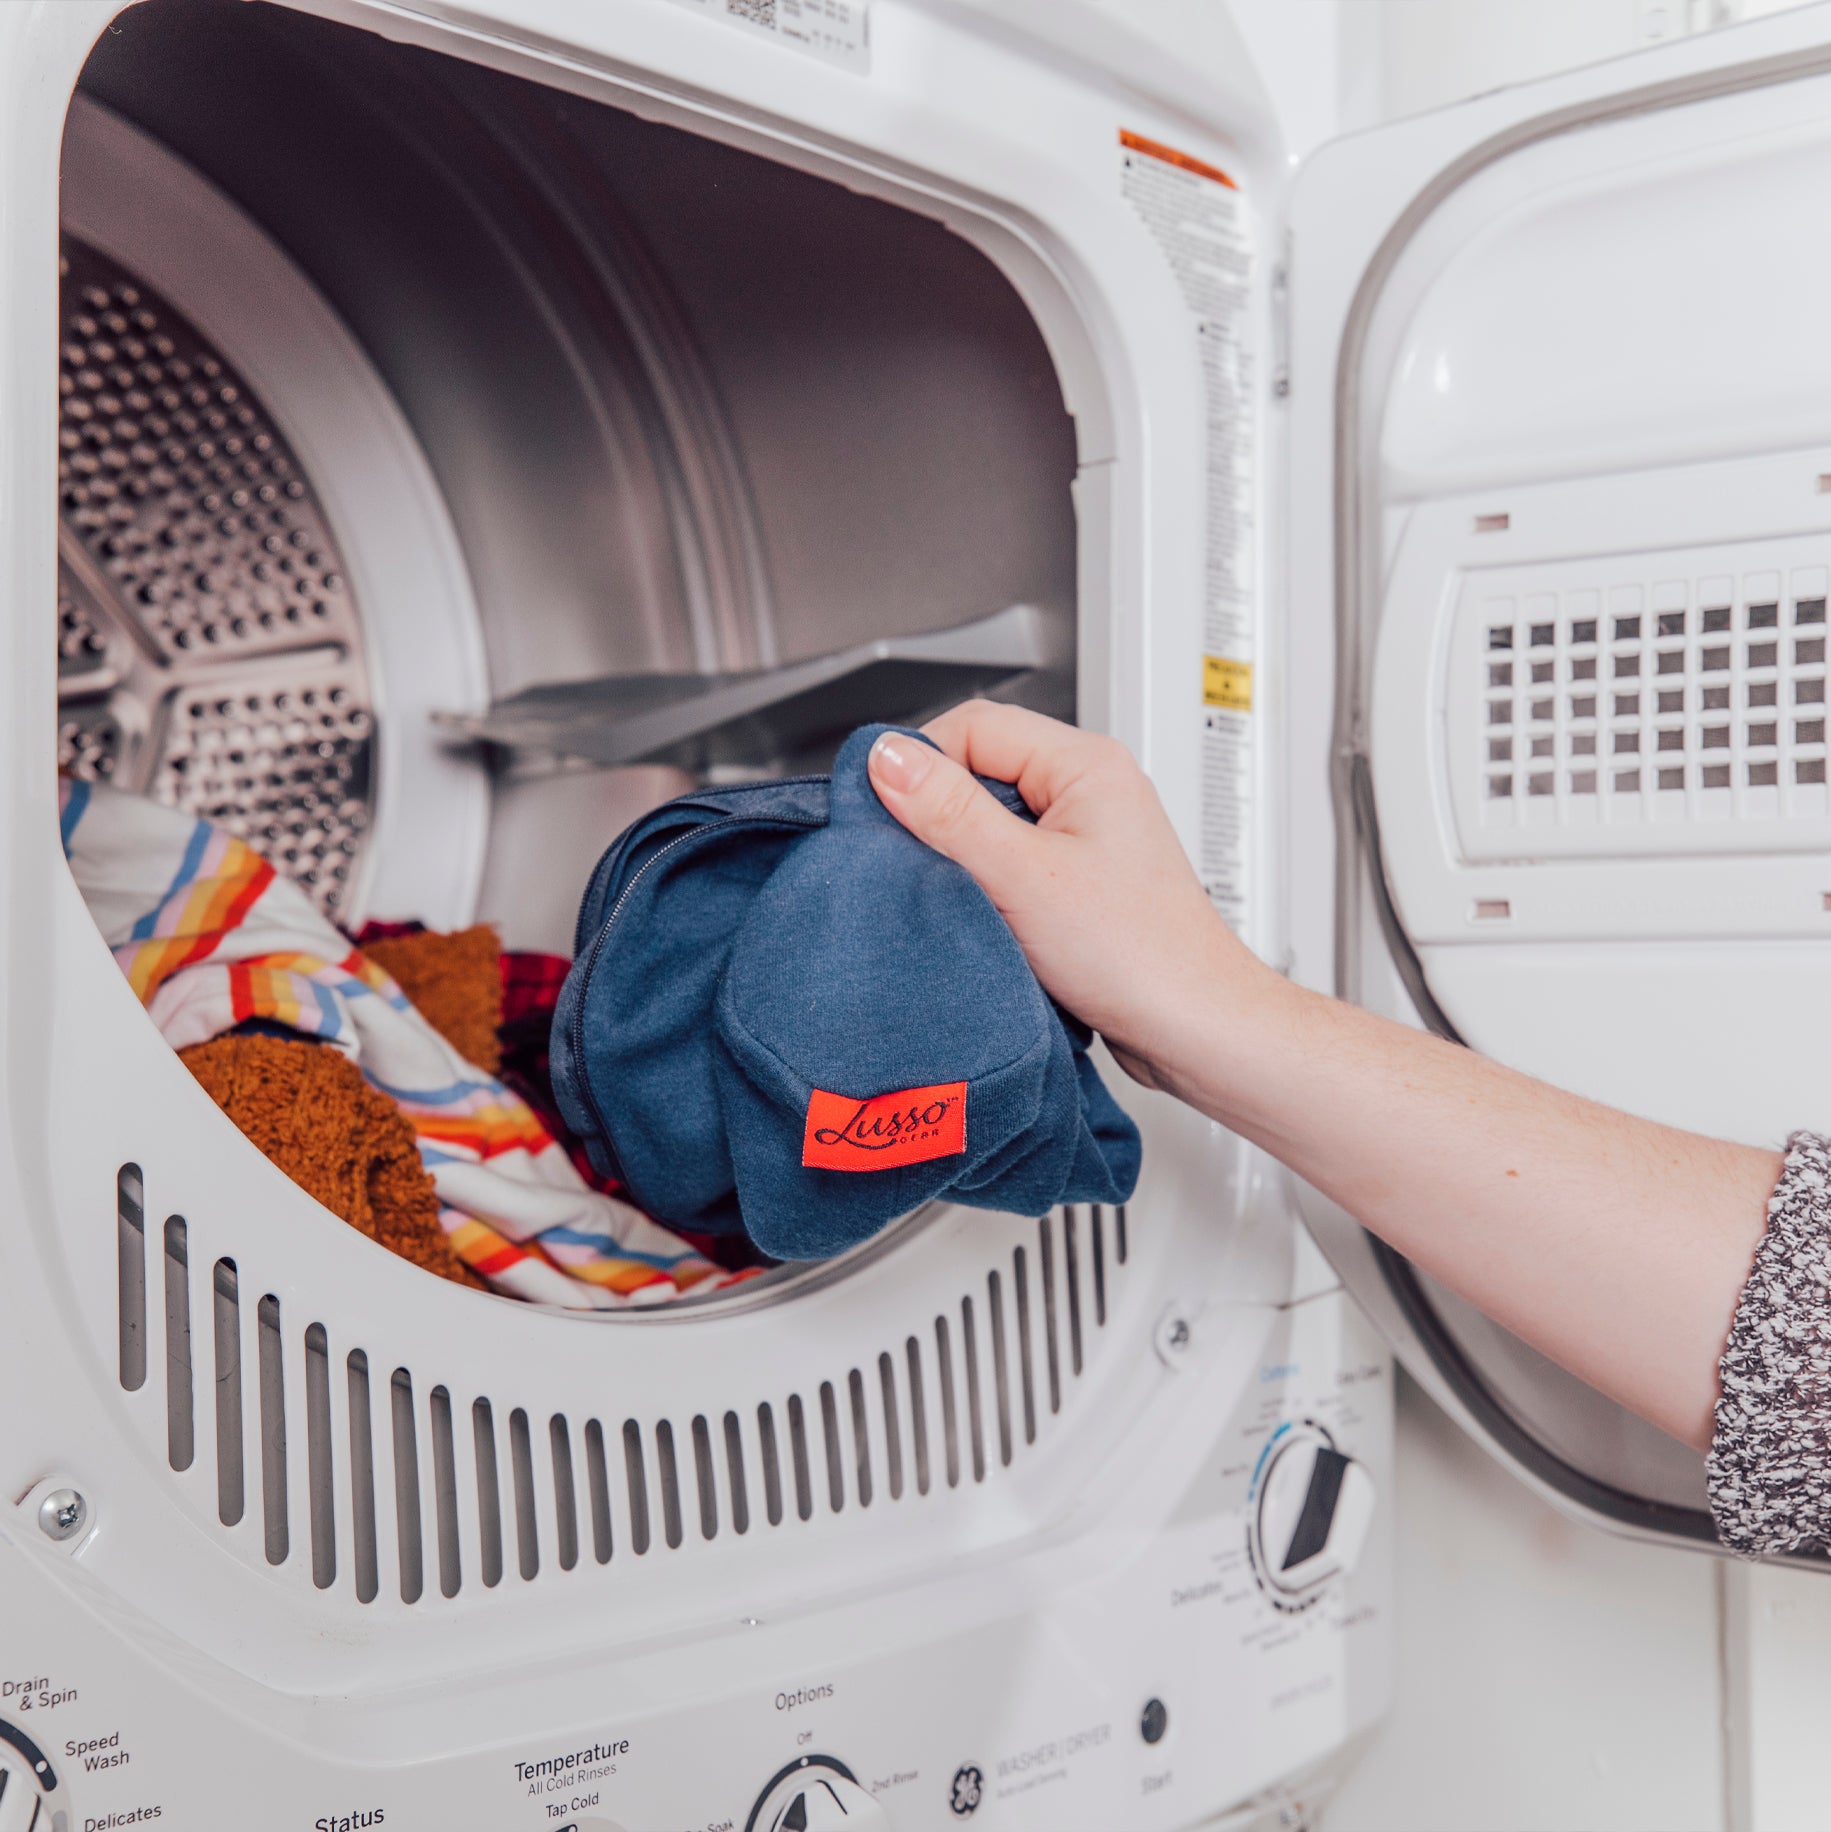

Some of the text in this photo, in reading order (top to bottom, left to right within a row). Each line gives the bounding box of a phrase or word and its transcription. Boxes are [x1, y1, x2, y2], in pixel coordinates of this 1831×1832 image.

[814, 1101, 948, 1150] Lusso
[2, 1676, 49, 1697] Drain
[19, 1689, 78, 1711] & Spin
[775, 1683, 834, 1711] Options
[65, 1731, 120, 1758] Speed
[796, 1731, 813, 1745] Off
[84, 1751, 130, 1772] Wash
[514, 1739, 630, 1782] Temperature
[527, 1763, 617, 1798] All Cold Rinses
[84, 1805, 162, 1832] Delicates
[315, 1806, 385, 1832] Status
[546, 1792, 600, 1819] Tap Cold
